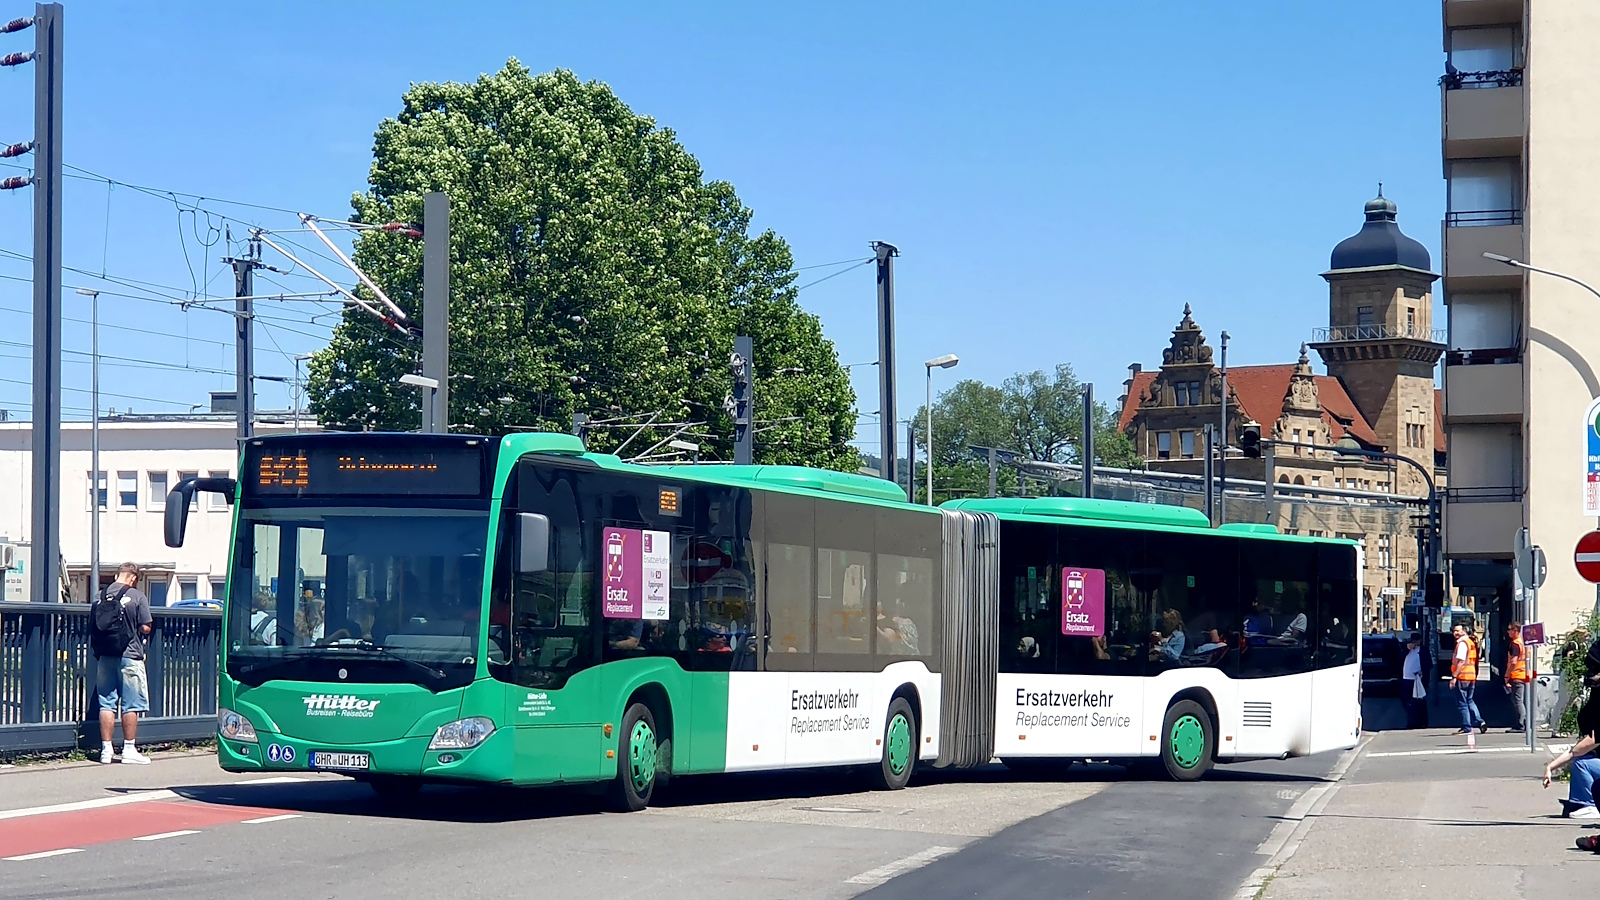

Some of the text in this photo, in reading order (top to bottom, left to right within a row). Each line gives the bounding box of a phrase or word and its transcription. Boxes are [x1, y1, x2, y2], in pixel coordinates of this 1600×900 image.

[607, 585, 628, 601] Ersatz
[607, 602, 633, 614] Replacement
[1066, 611, 1089, 624] Ersatz
[1066, 623, 1095, 633] Replacement
[302, 694, 380, 710] Hütter
[791, 688, 859, 710] Ersatzverkehr
[1016, 688, 1113, 707] Ersatzverkehr
[306, 708, 336, 717] Busreisen
[341, 709, 374, 718] Reisebüro
[1016, 711, 1130, 729] Replacement Service
[791, 714, 870, 737] Replacement Service
[315, 753, 368, 767] ÖHR UH 113
